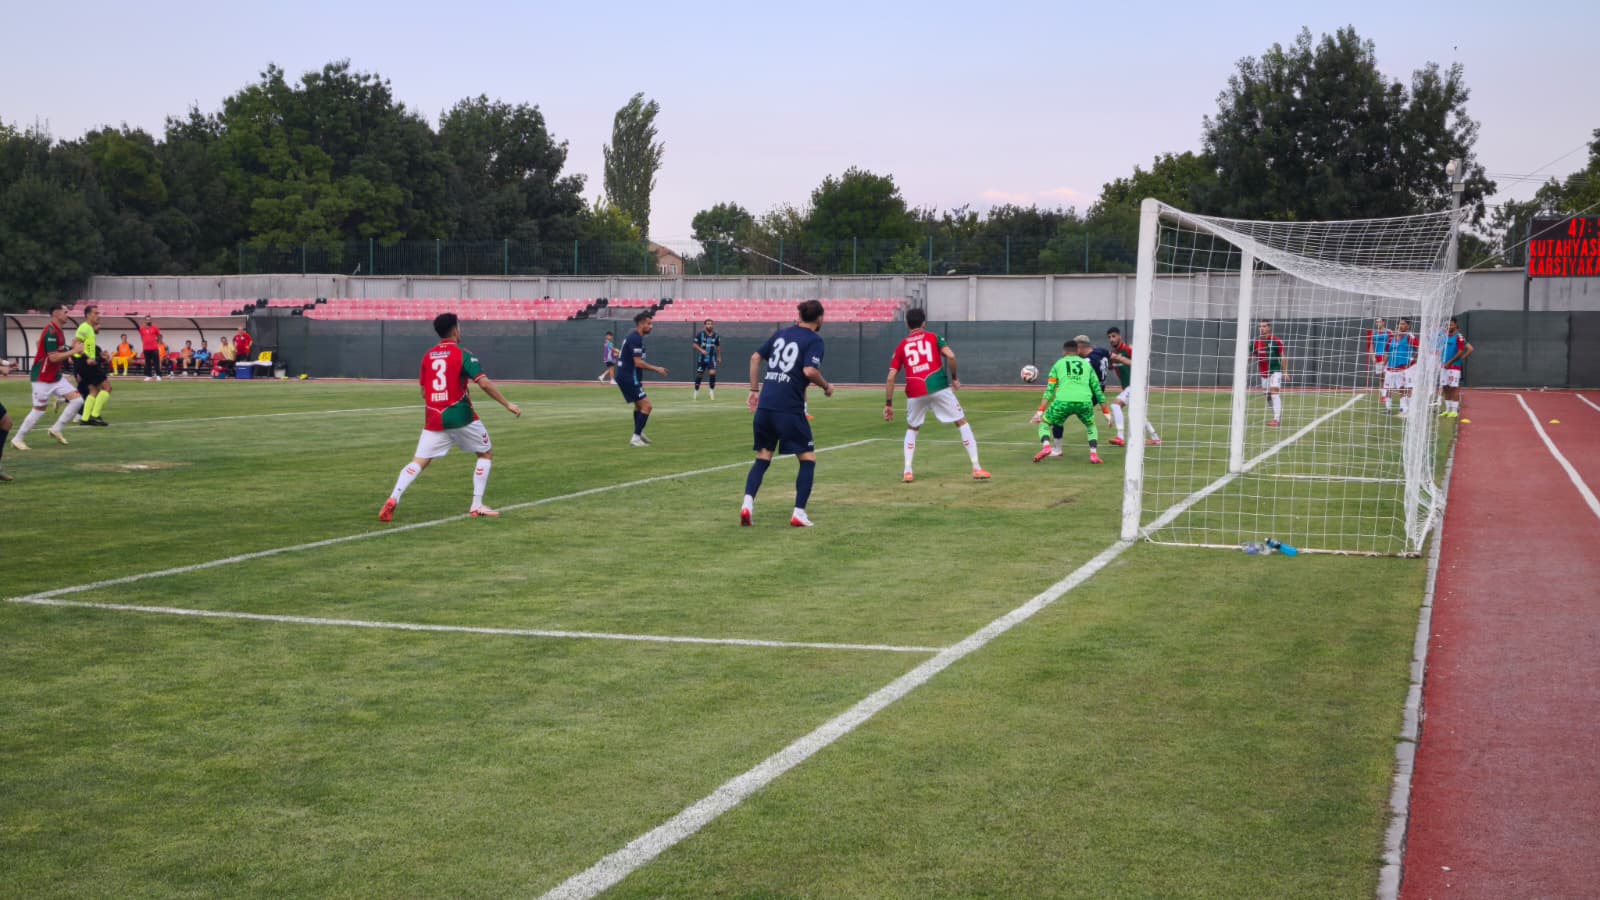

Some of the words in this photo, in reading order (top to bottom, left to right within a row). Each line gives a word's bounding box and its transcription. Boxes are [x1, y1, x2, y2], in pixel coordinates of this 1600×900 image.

[769, 337, 799, 372] 39
[904, 340, 932, 366] 54
[431, 358, 447, 391] 3
[1066, 360, 1083, 376] 13
